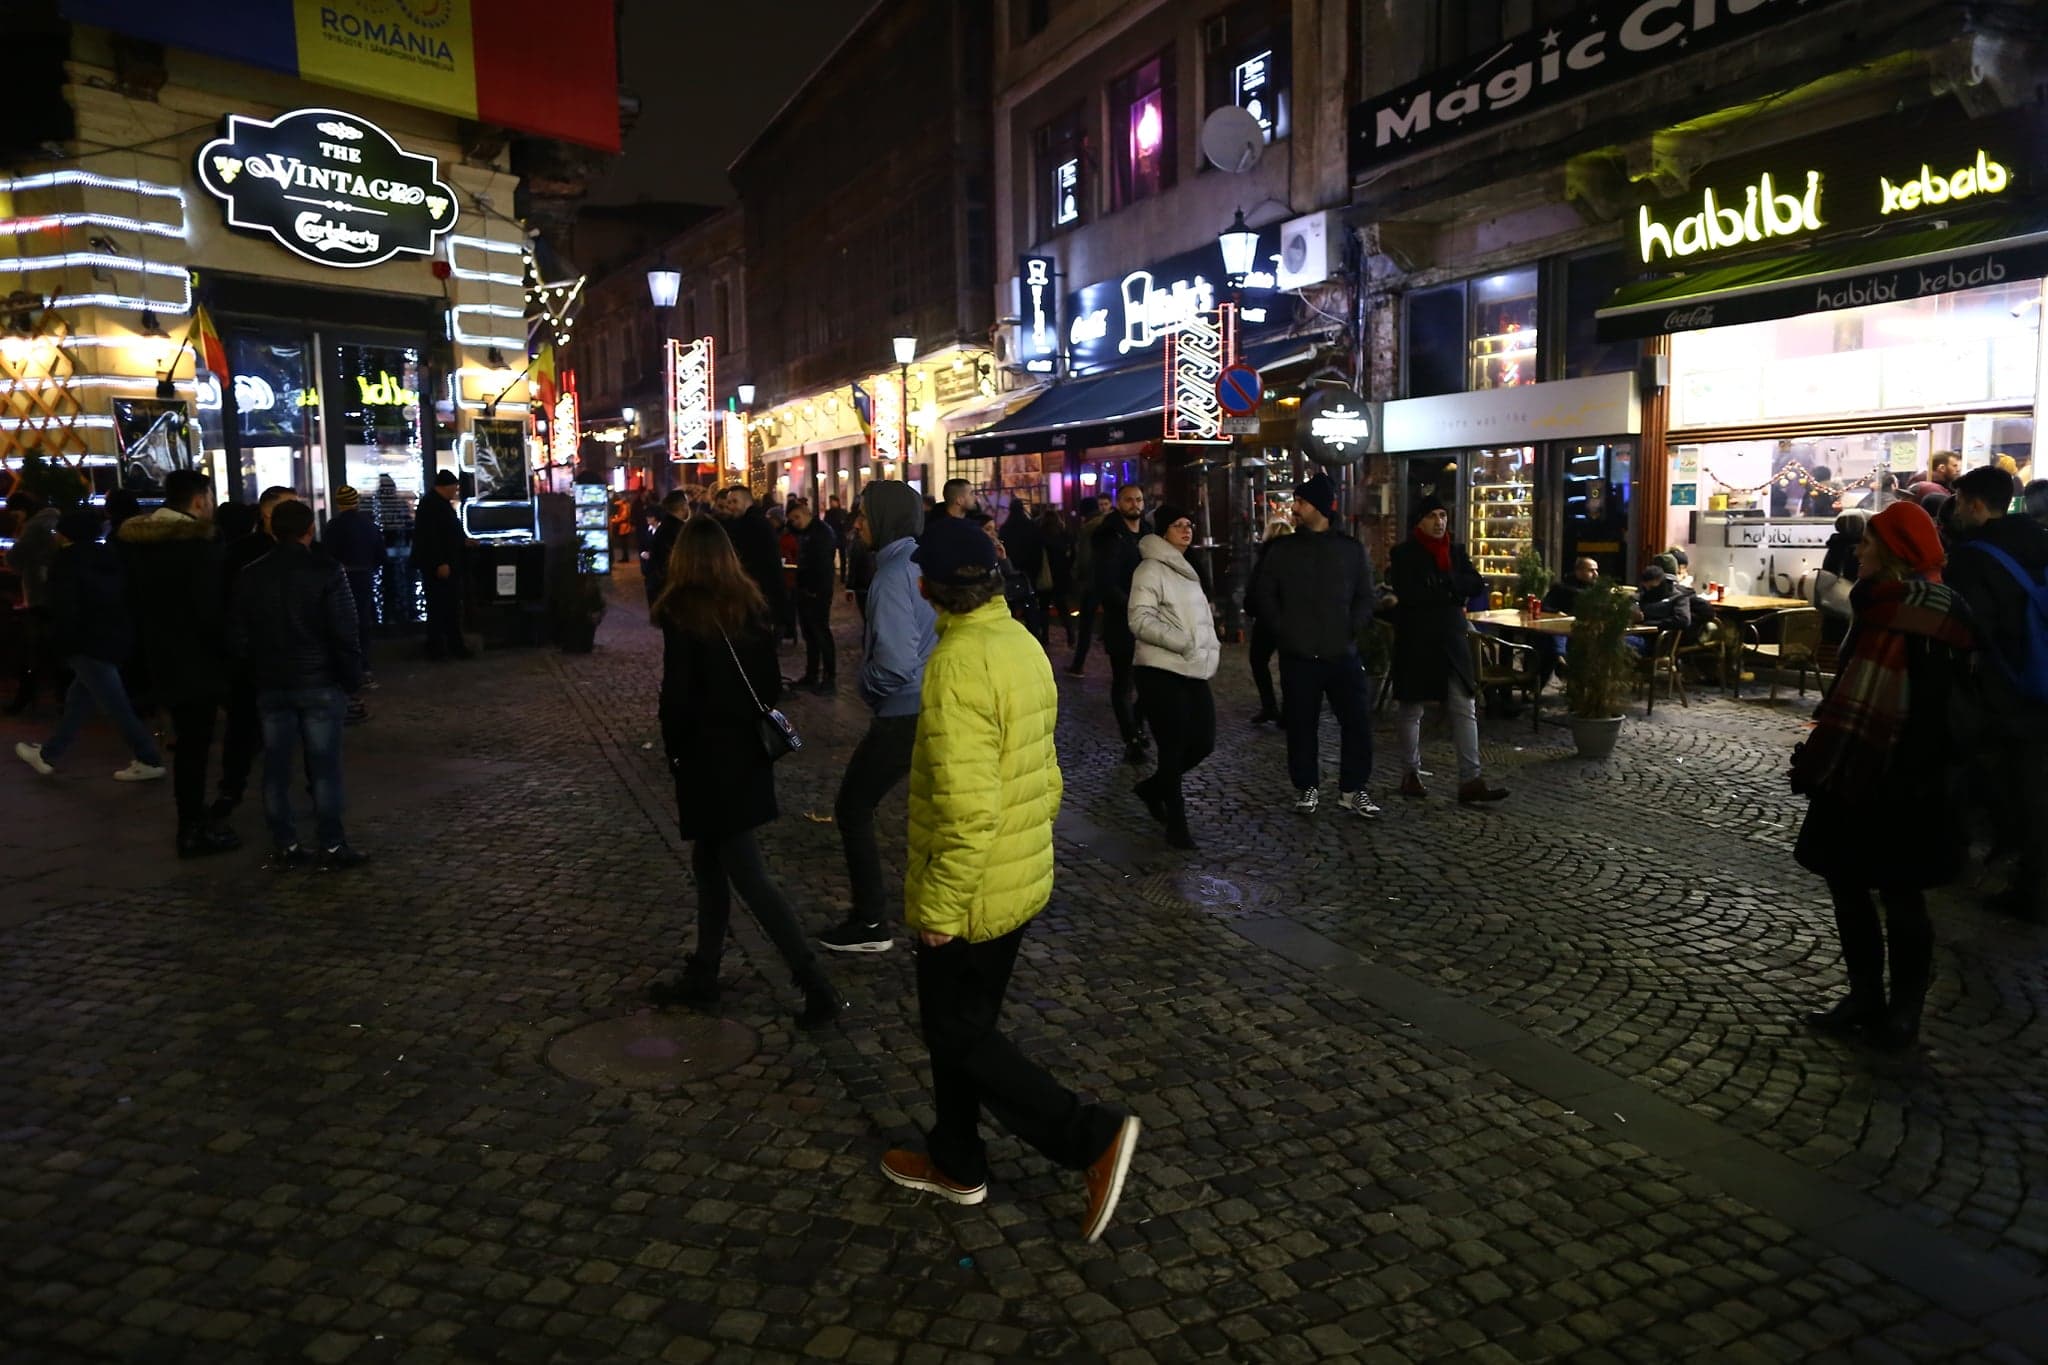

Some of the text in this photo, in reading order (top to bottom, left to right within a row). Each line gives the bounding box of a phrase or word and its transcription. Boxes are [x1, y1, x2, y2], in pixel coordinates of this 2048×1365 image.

[320, 6, 454, 63] ROMÂNIA
[1375, 28, 1606, 148] Magic
[254, 153, 418, 205] VINTAGE
[319, 141, 361, 164] THE
[295, 211, 379, 253] Carlsberg
[1639, 149, 2008, 263] habibi kebab
[1816, 256, 2006, 310] habibi kebab
